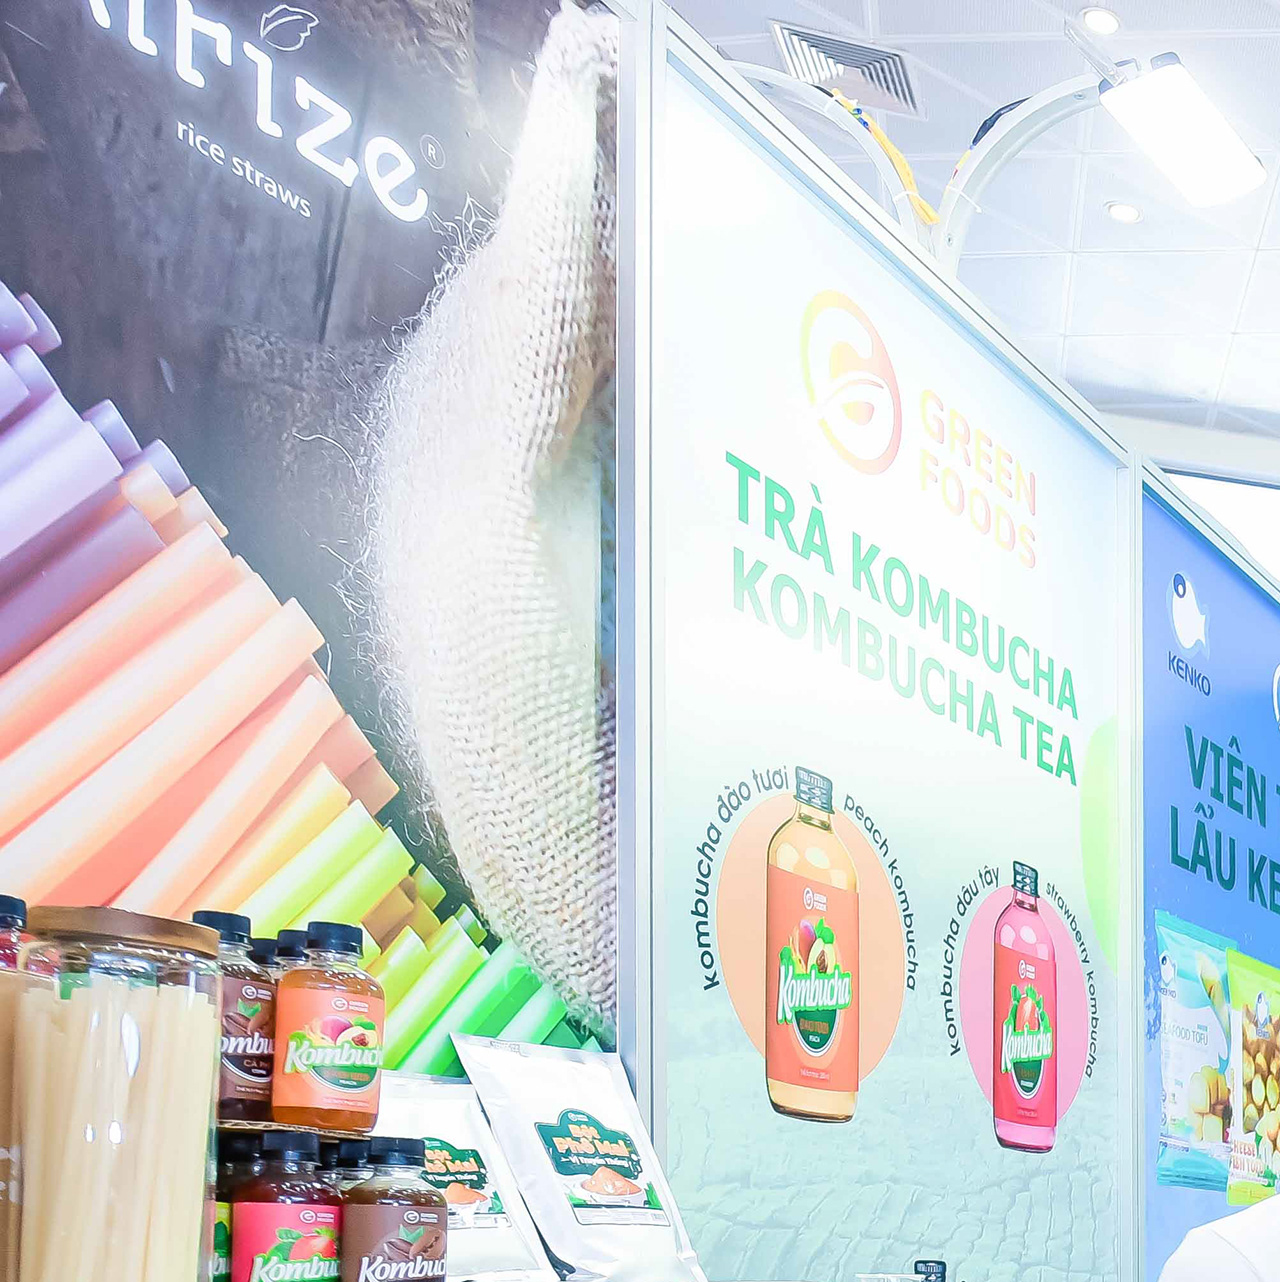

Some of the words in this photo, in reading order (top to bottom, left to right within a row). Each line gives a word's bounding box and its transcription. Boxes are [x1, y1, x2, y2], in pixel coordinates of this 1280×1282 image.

[88, 0, 429, 223] rize
[176, 120, 226, 166] rice
[231, 155, 311, 218] straws
[919, 389, 1036, 516] GREEN
[919, 448, 1036, 569] FOODS
[725, 450, 834, 576] TRÀ
[851, 531, 1079, 720] KOMBUCHA
[732, 546, 1003, 748] KOMBUCHA
[1012, 705, 1077, 787] TEA
[1168, 650, 1211, 697] KENKO
[1184, 723, 1266, 829] VIÊN
[690, 821, 722, 990] kombucha
[717, 778, 752, 824] đào
[752, 765, 790, 794] tươi
[843, 793, 890, 857] peach
[887, 858, 920, 991] kombucha
[1169, 801, 1236, 892] LẨU
[777, 963, 851, 1023] Kombucha
[940, 915, 962, 1057] kombucha
[955, 887, 978, 917] dâu
[978, 865, 1000, 893] tây
[1045, 881, 1091, 965] strawberry
[1085, 969, 1100, 1079] kombucha
[1000, 1022, 1053, 1073] Kombucha
[1192, 1028, 1209, 1046] TOFU
